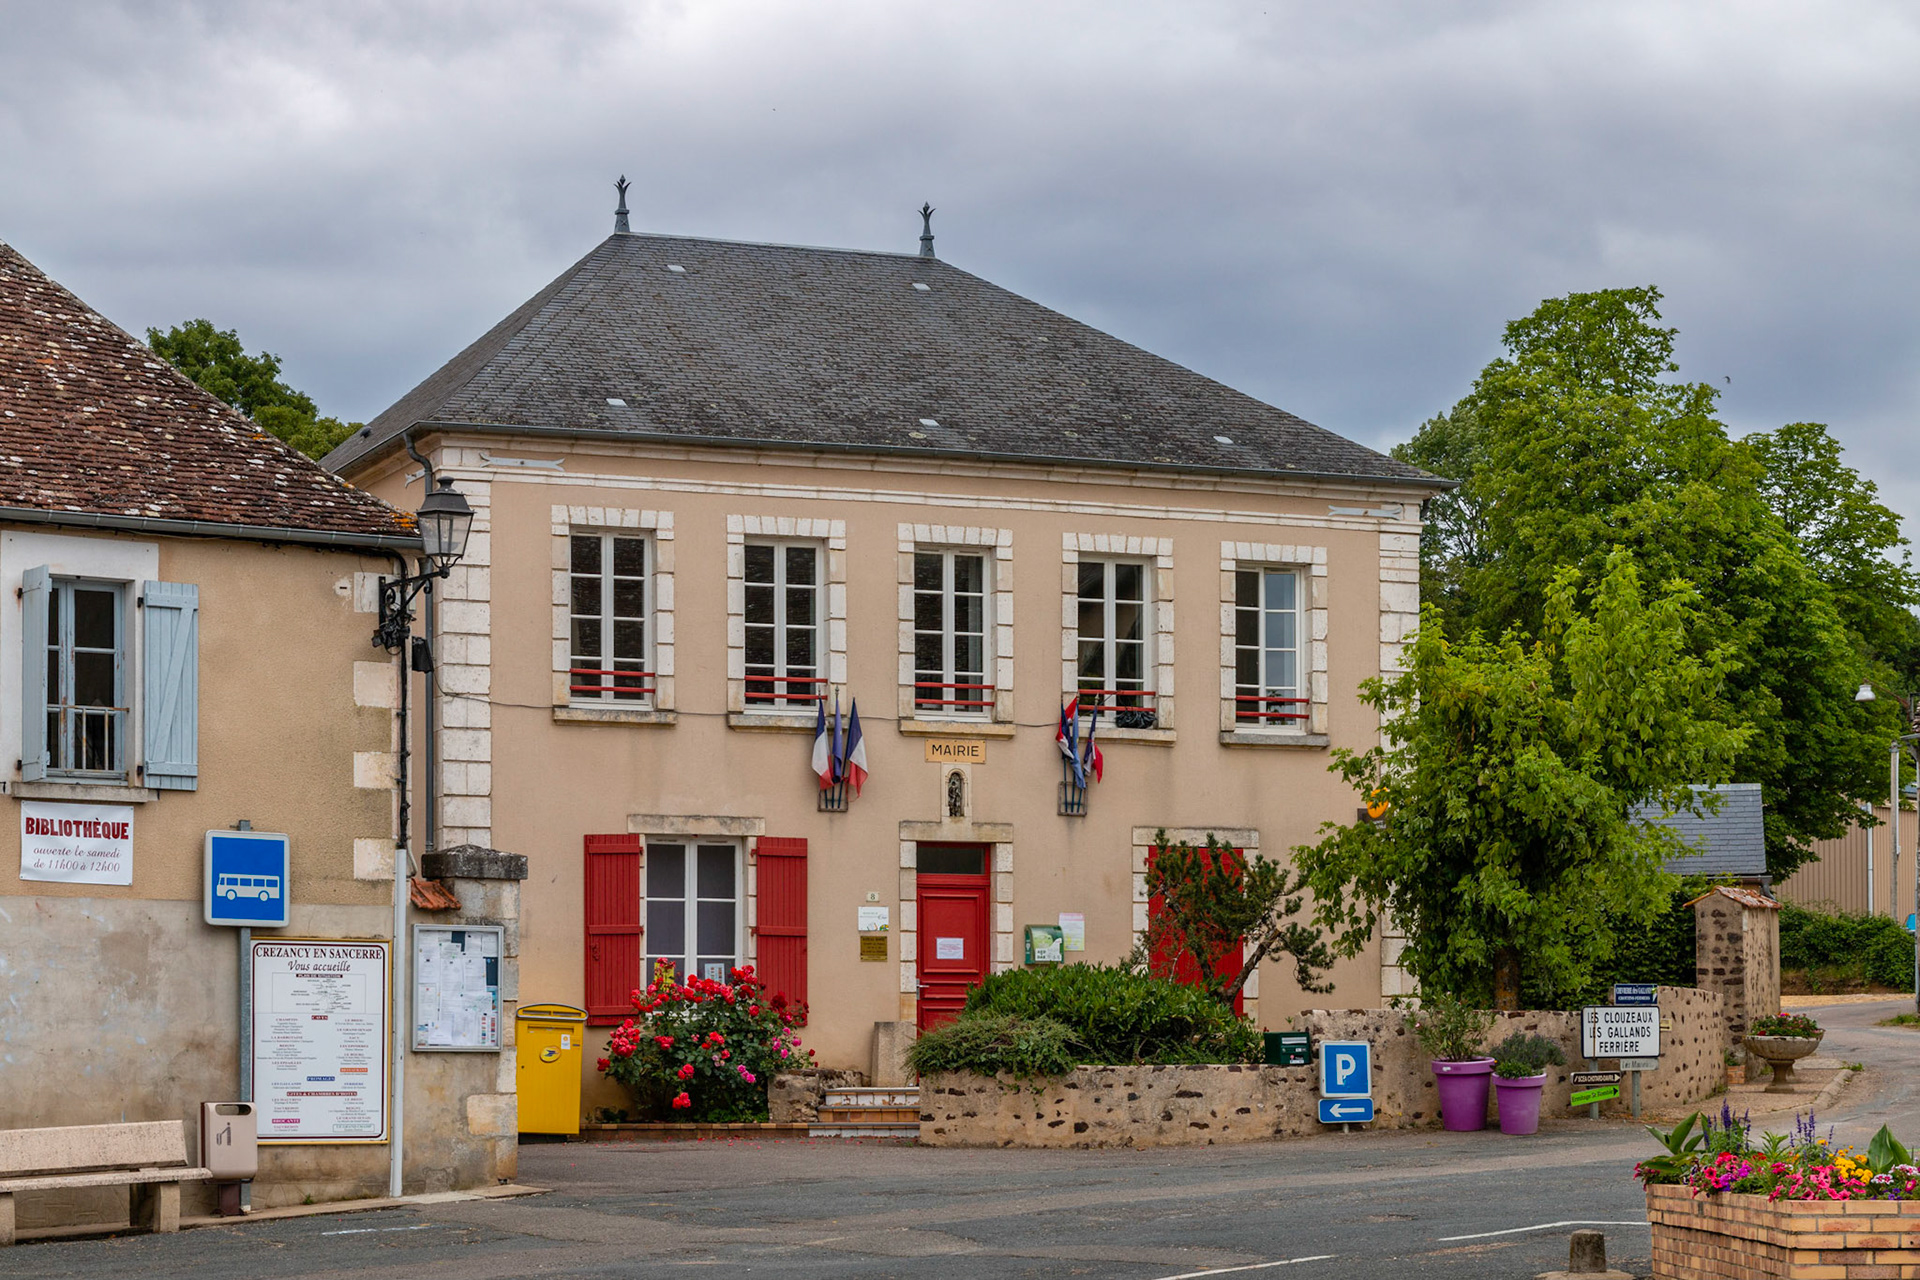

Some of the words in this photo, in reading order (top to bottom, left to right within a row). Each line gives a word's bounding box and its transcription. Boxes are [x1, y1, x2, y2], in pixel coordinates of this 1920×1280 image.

[932, 745, 979, 756] MAIRIE
[26, 818, 129, 840] BIBLIOTHÈQUE
[34, 846, 72, 856] ouverte
[75, 846, 86, 857] le
[86, 848, 121, 858] samedi
[34, 858, 45, 868] de
[48, 859, 78, 870] 11h00
[80, 862, 88, 871] à
[90, 862, 120, 872] 12h00
[256, 947, 311, 958] CREZANCY
[313, 948, 328, 958] EN
[330, 949, 382, 959] SANCERRE
[288, 961, 310, 971] Vous
[313, 961, 350, 971] accueille
[1588, 1012, 1599, 1023] LES
[1604, 1012, 1653, 1023] CLOUZEAUX
[1608, 1026, 1650, 1038] GALLANDS
[1599, 1040, 1639, 1052] FERRIÈRE
[1336, 1054, 1356, 1085] P
